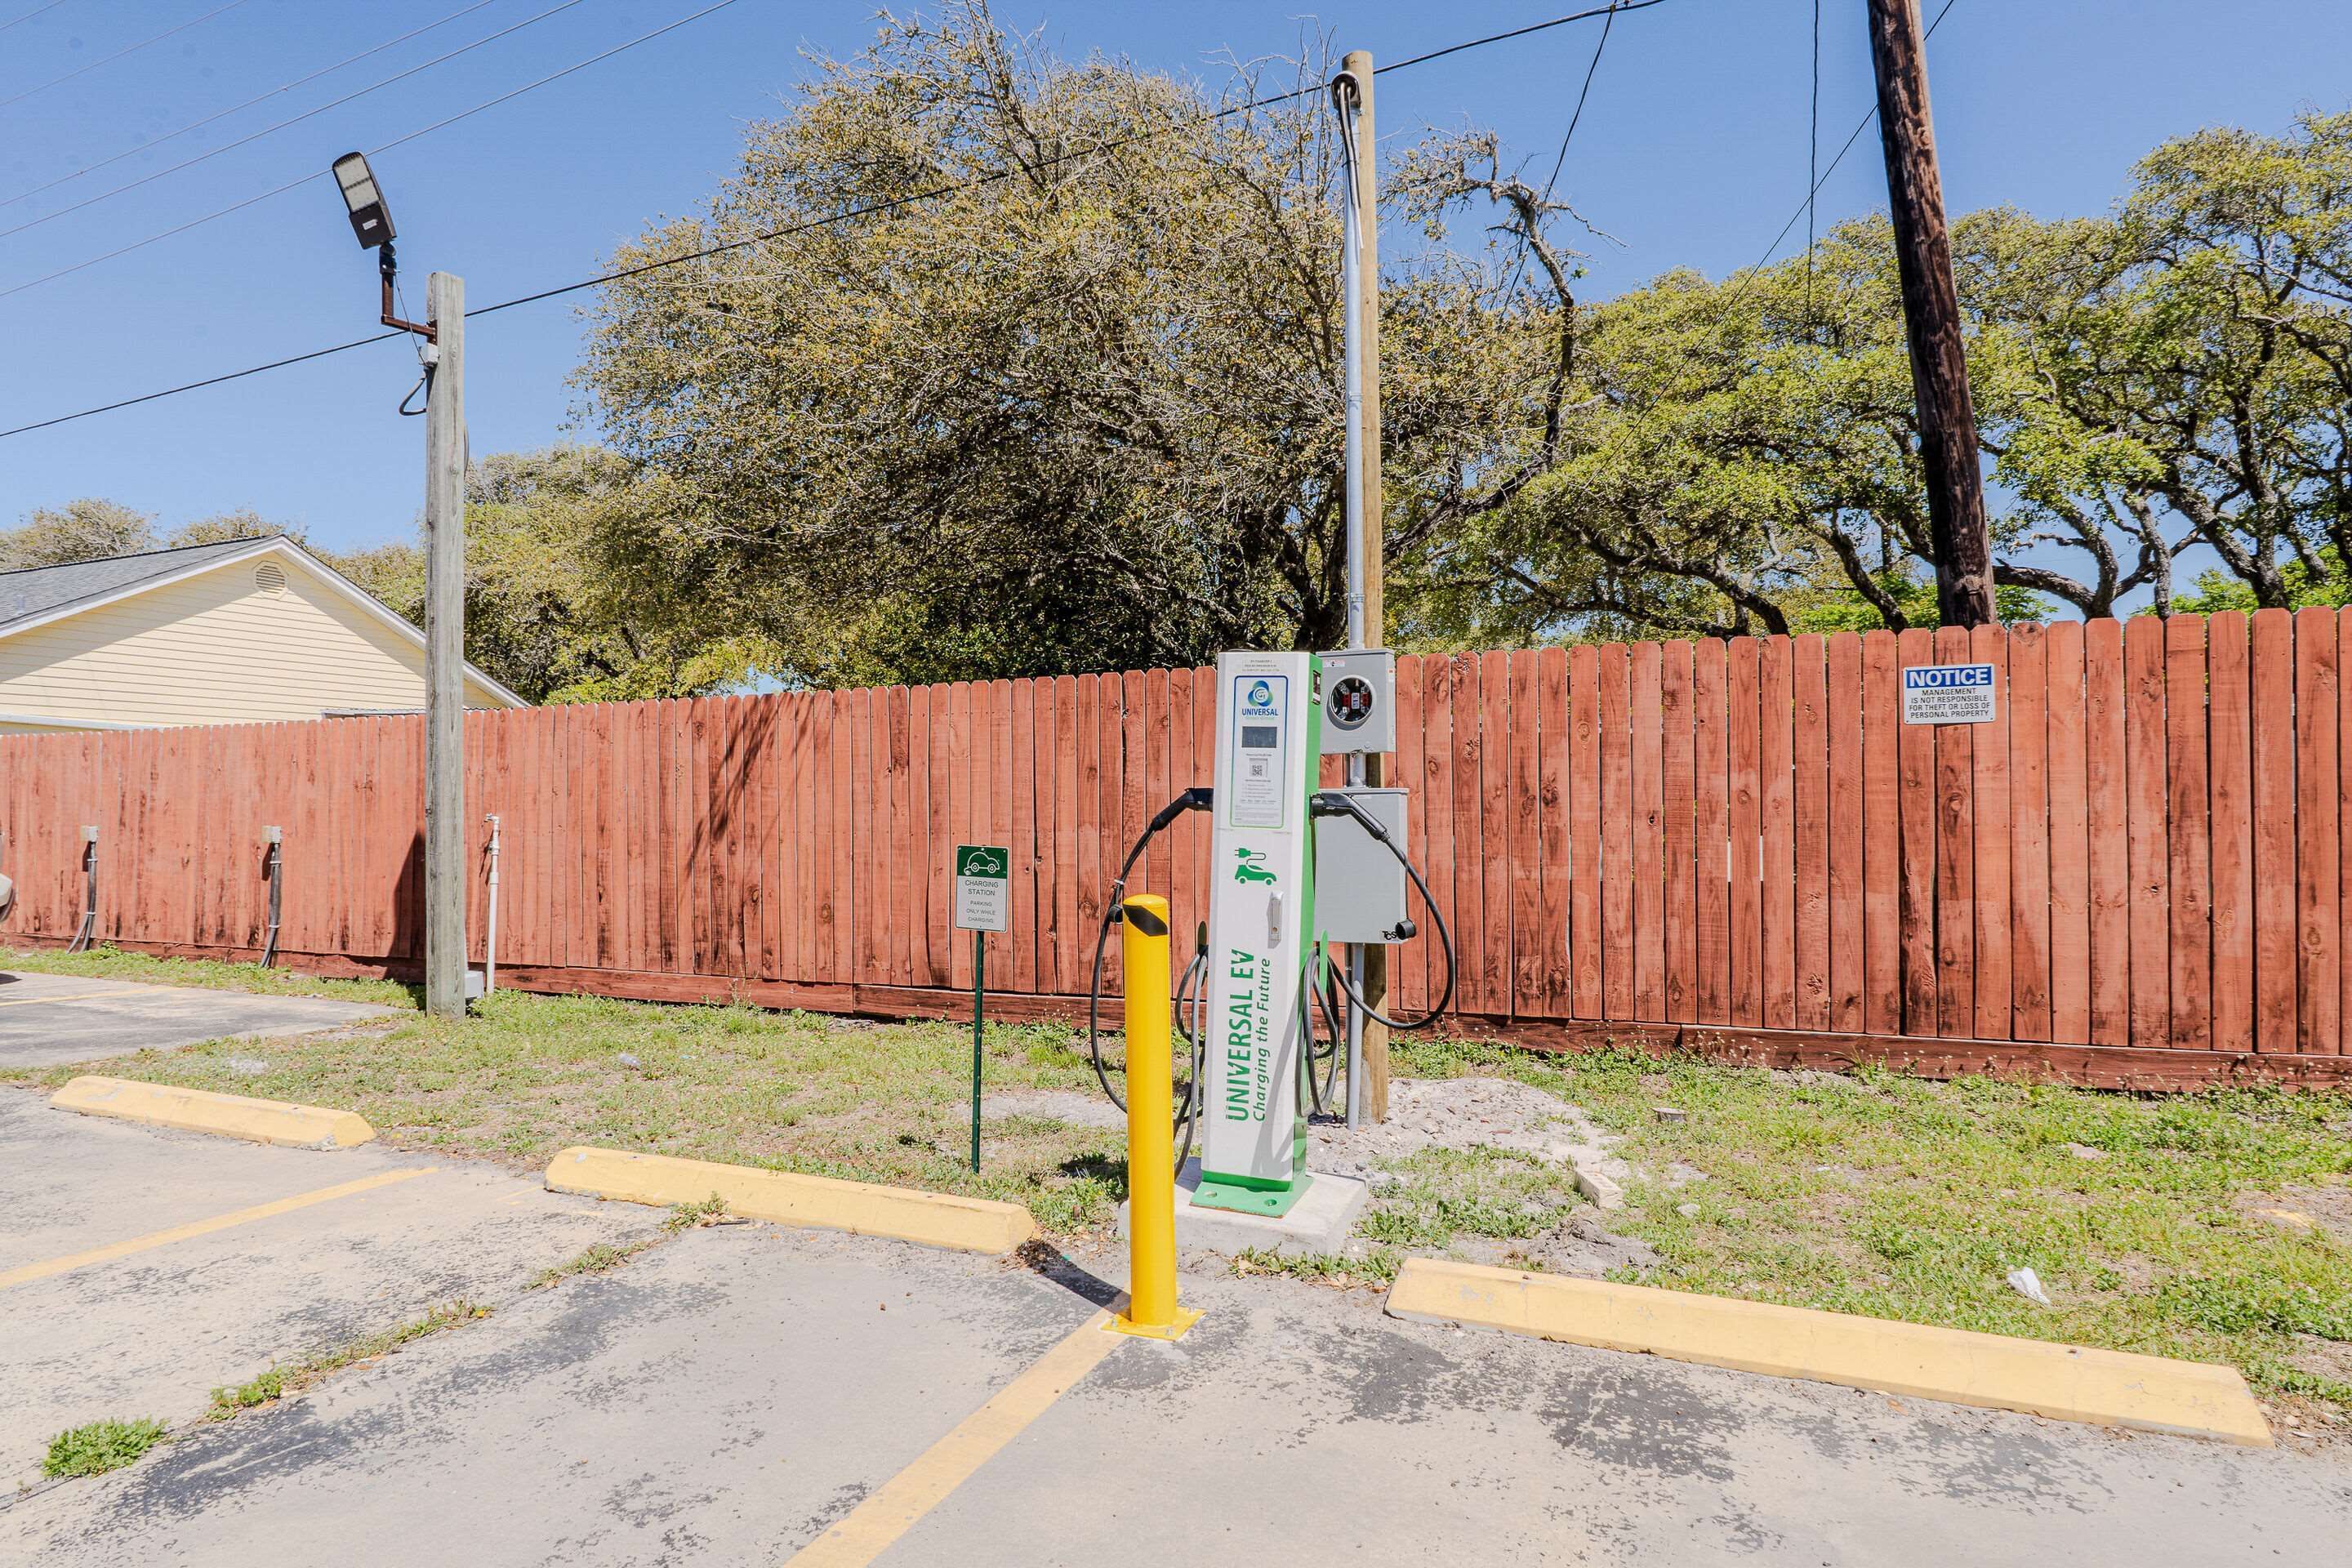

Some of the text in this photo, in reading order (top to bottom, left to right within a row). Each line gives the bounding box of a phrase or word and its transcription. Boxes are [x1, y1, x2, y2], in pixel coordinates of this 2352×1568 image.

[1909, 669, 1989, 687] NOTICE
[1241, 708, 1279, 716] UNIVERSAL
[1910, 710, 1949, 719] PERSONAL
[964, 880, 999, 888] CHARGING
[1227, 949, 1254, 1121] UNIVERSAL EV
[1254, 958, 1271, 1121] Charging the Future
